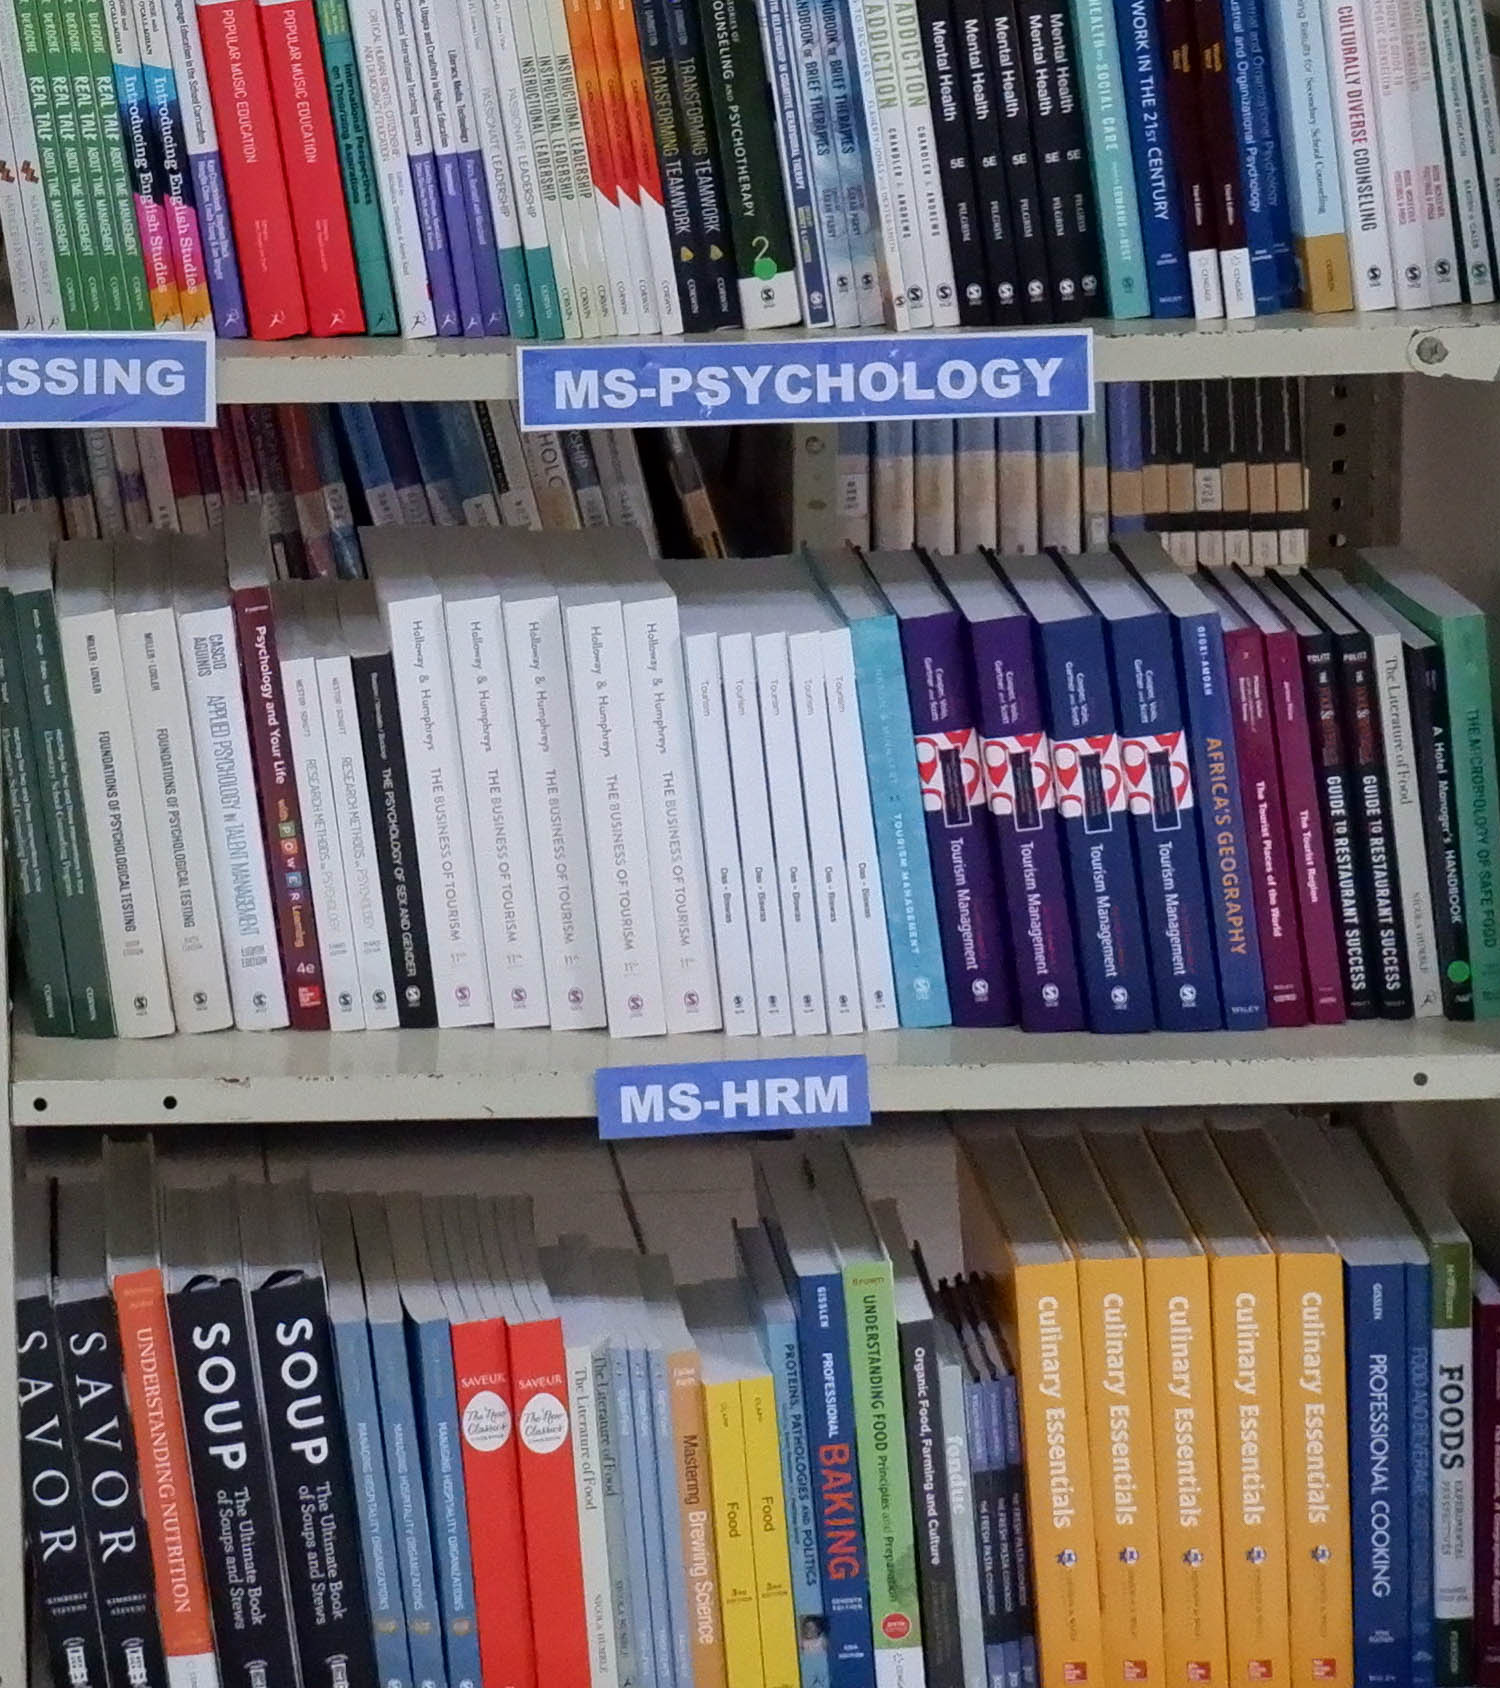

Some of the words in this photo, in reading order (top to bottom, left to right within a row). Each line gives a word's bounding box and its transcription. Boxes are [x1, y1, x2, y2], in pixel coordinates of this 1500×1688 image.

[221, 8, 241, 60] POPULAR
[1337, 4, 1361, 86] CULTURALLY
[230, 62, 247, 98] MUSIC
[1347, 89, 1368, 144] DIVERSE
[236, 101, 257, 163] EDUCATION
[1352, 147, 1377, 231] COUNSELING
[554, 358, 1063, 410] MS-PSYCHOLOGY
[1205, 736, 1232, 826] AFRICA'S
[1361, 774, 1380, 816] GUIDE
[1088, 843, 1108, 892] Tourism
[1216, 830, 1248, 956] GEOGRAPHY
[1368, 836, 1393, 924] RESTAURANT
[1091, 894, 1119, 977] Management
[1379, 927, 1401, 990] SUCCESS
[620, 1074, 848, 1123] MS-HRM
[1033, 1294, 1065, 1398] Culinary
[1228, 1291, 1260, 1395] Culinary
[193, 1322, 247, 1470] SOUP
[276, 1318, 329, 1465] SOUP
[821, 1351, 838, 1437] PROFESSIONAL
[1367, 1354, 1388, 1493] PROFESSIONAL
[1438, 1364, 1464, 1470] FOODS
[70, 1331, 136, 1562] SAVOR
[134, 1326, 175, 1499] UNDERSTANDING
[159, 1501, 191, 1613] NUTRITION
[1044, 1406, 1075, 1528] Essentials
[1237, 1403, 1265, 1524] Essentials
[816, 1442, 860, 1580] BAKING
[1369, 1500, 1390, 1597] COOKING
